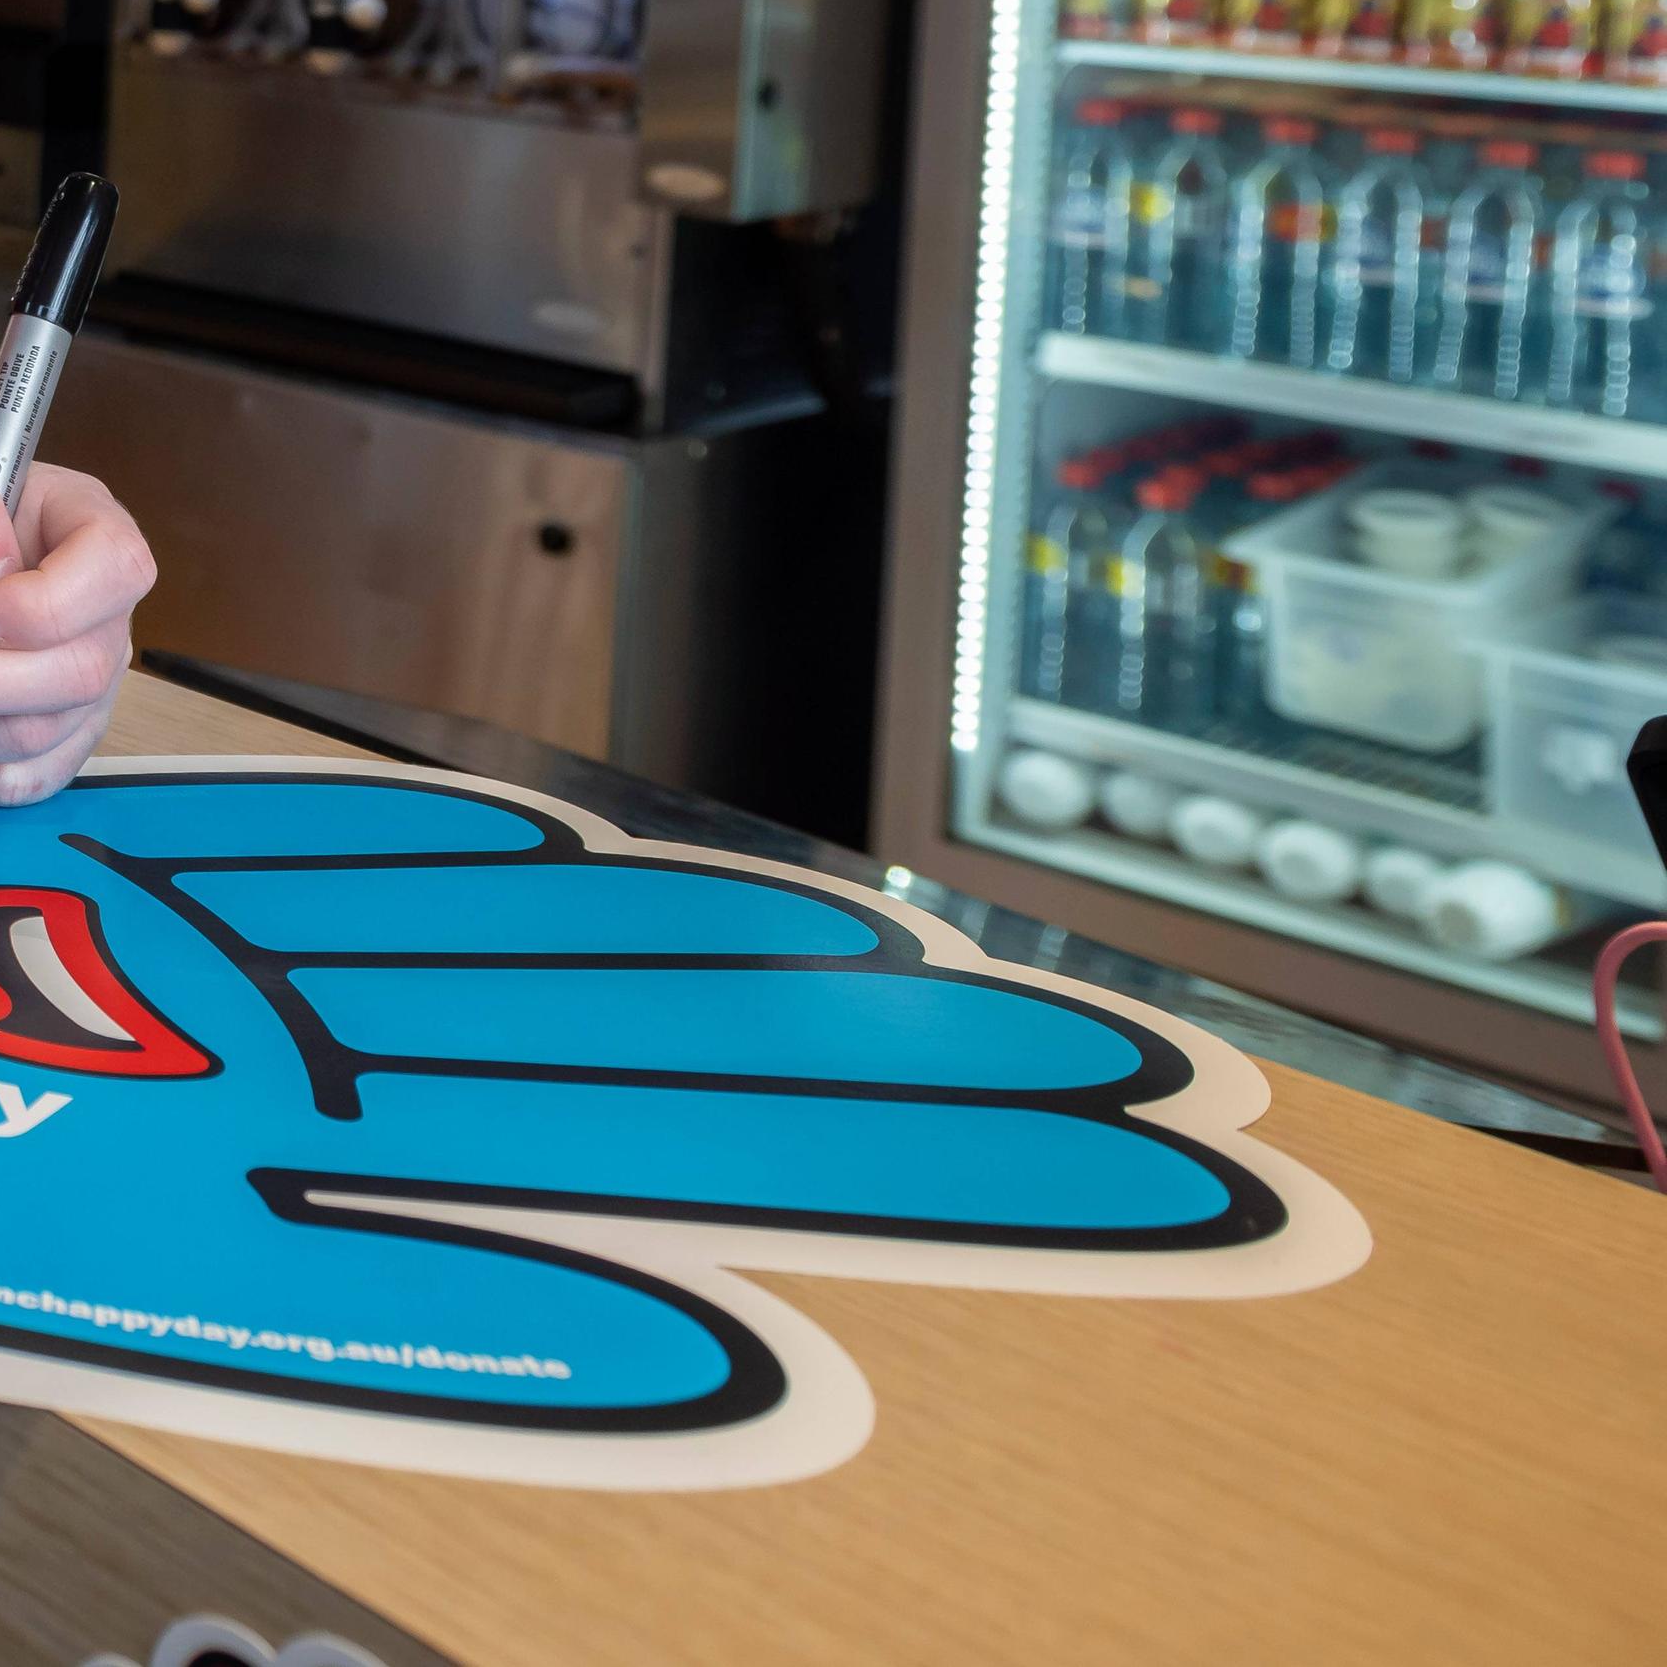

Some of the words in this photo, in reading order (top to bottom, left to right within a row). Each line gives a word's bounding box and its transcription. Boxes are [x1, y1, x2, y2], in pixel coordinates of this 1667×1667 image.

[0, 361, 10, 376] TIP
[10, 385, 28, 413] PUNTA
[20, 344, 42, 385] REDONDA
[23, 391, 44, 435] Marcador
[38, 350, 59, 397] permanente
